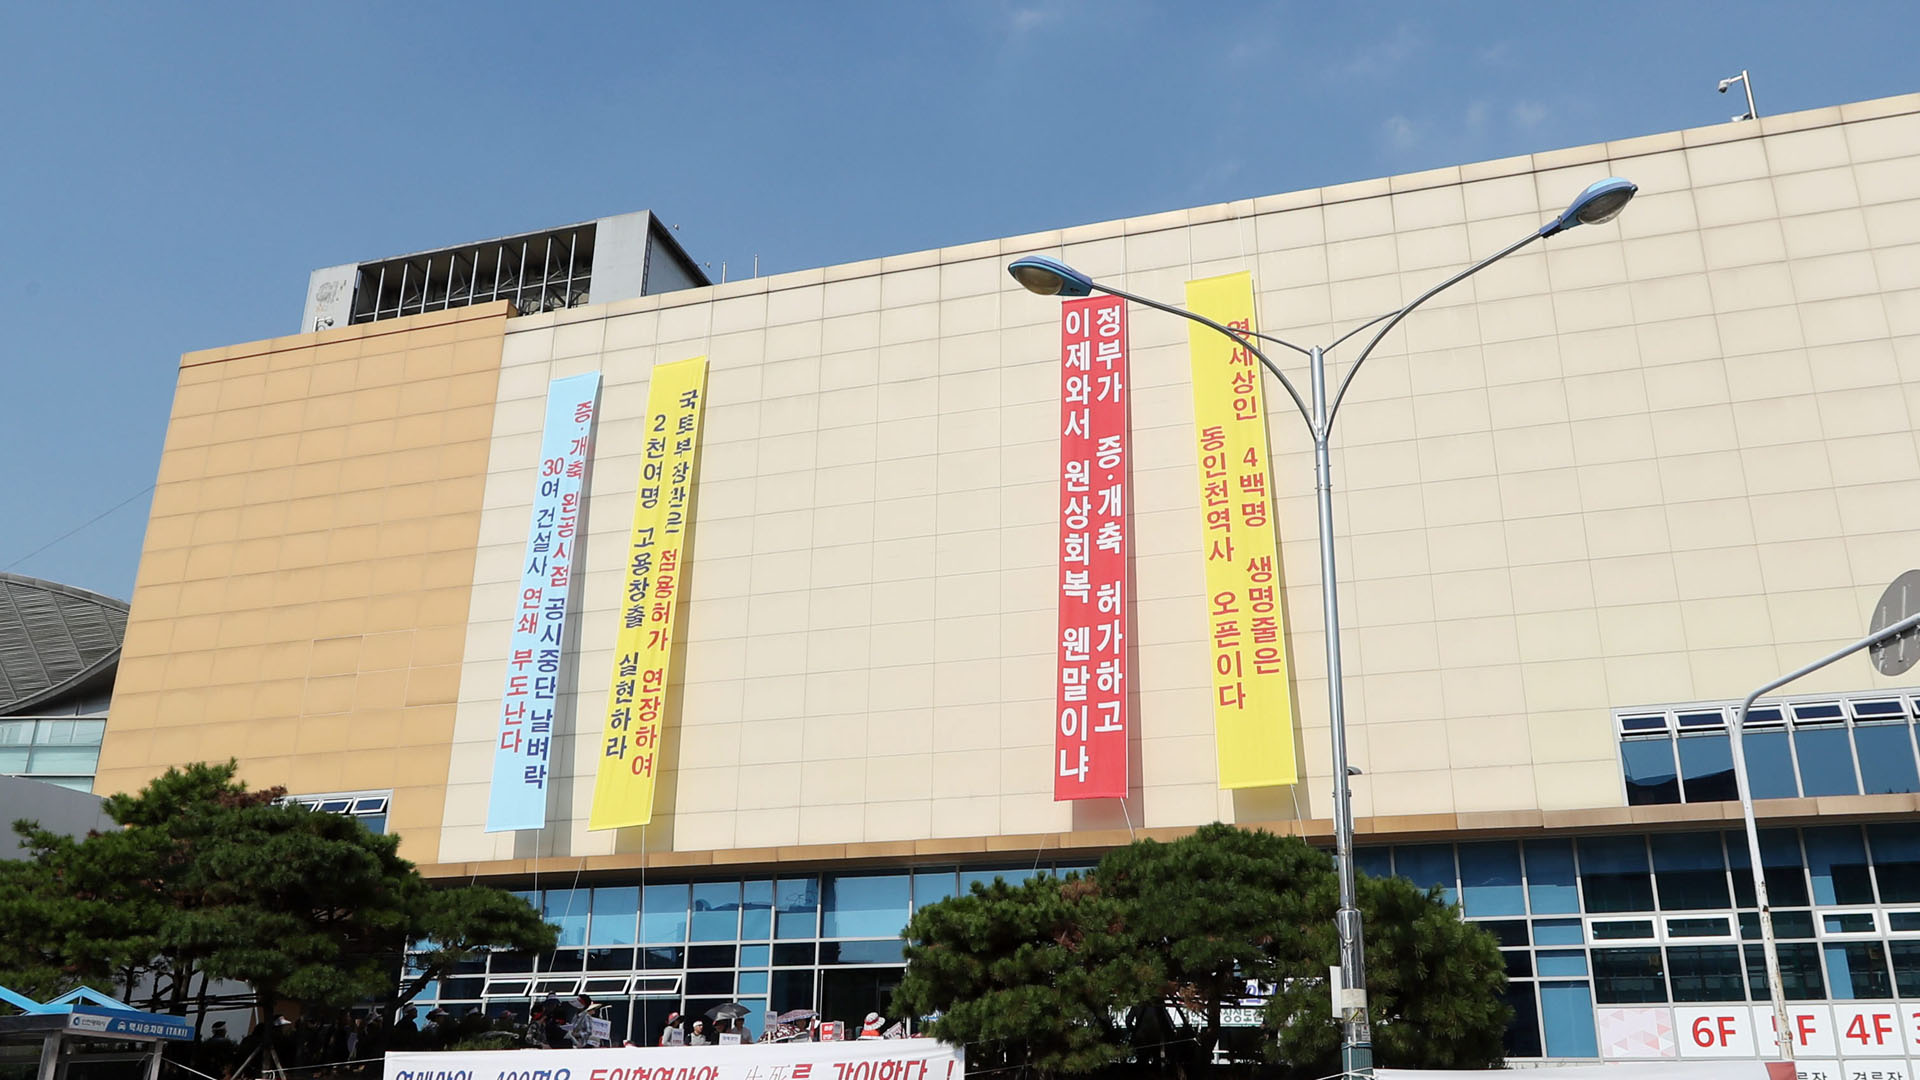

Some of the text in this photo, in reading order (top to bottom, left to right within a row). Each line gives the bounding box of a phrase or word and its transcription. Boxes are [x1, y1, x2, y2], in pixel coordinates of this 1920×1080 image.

[565, 401, 593, 480] 증·개축
[1094, 305, 1124, 732] 정부가 증·개축 허가하고
[1226, 318, 1281, 675] 영세상인 4백명 생명줄은
[500, 457, 565, 753] 30여 건설사 연쇄 부도난다
[605, 414, 666, 759] 2천여명 고용창출 실현하라
[646, 548, 678, 651] 점용허가
[1059, 307, 1092, 783] 이제와서 원상회복 웬말이냐
[1200, 425, 1246, 709] 동인천역사 오픈이다
[524, 709, 553, 789] 날벼락
[631, 667, 663, 778] 연장하여
[1692, 1016, 1736, 1047] 6F
[1845, 1013, 1893, 1046] 4F
